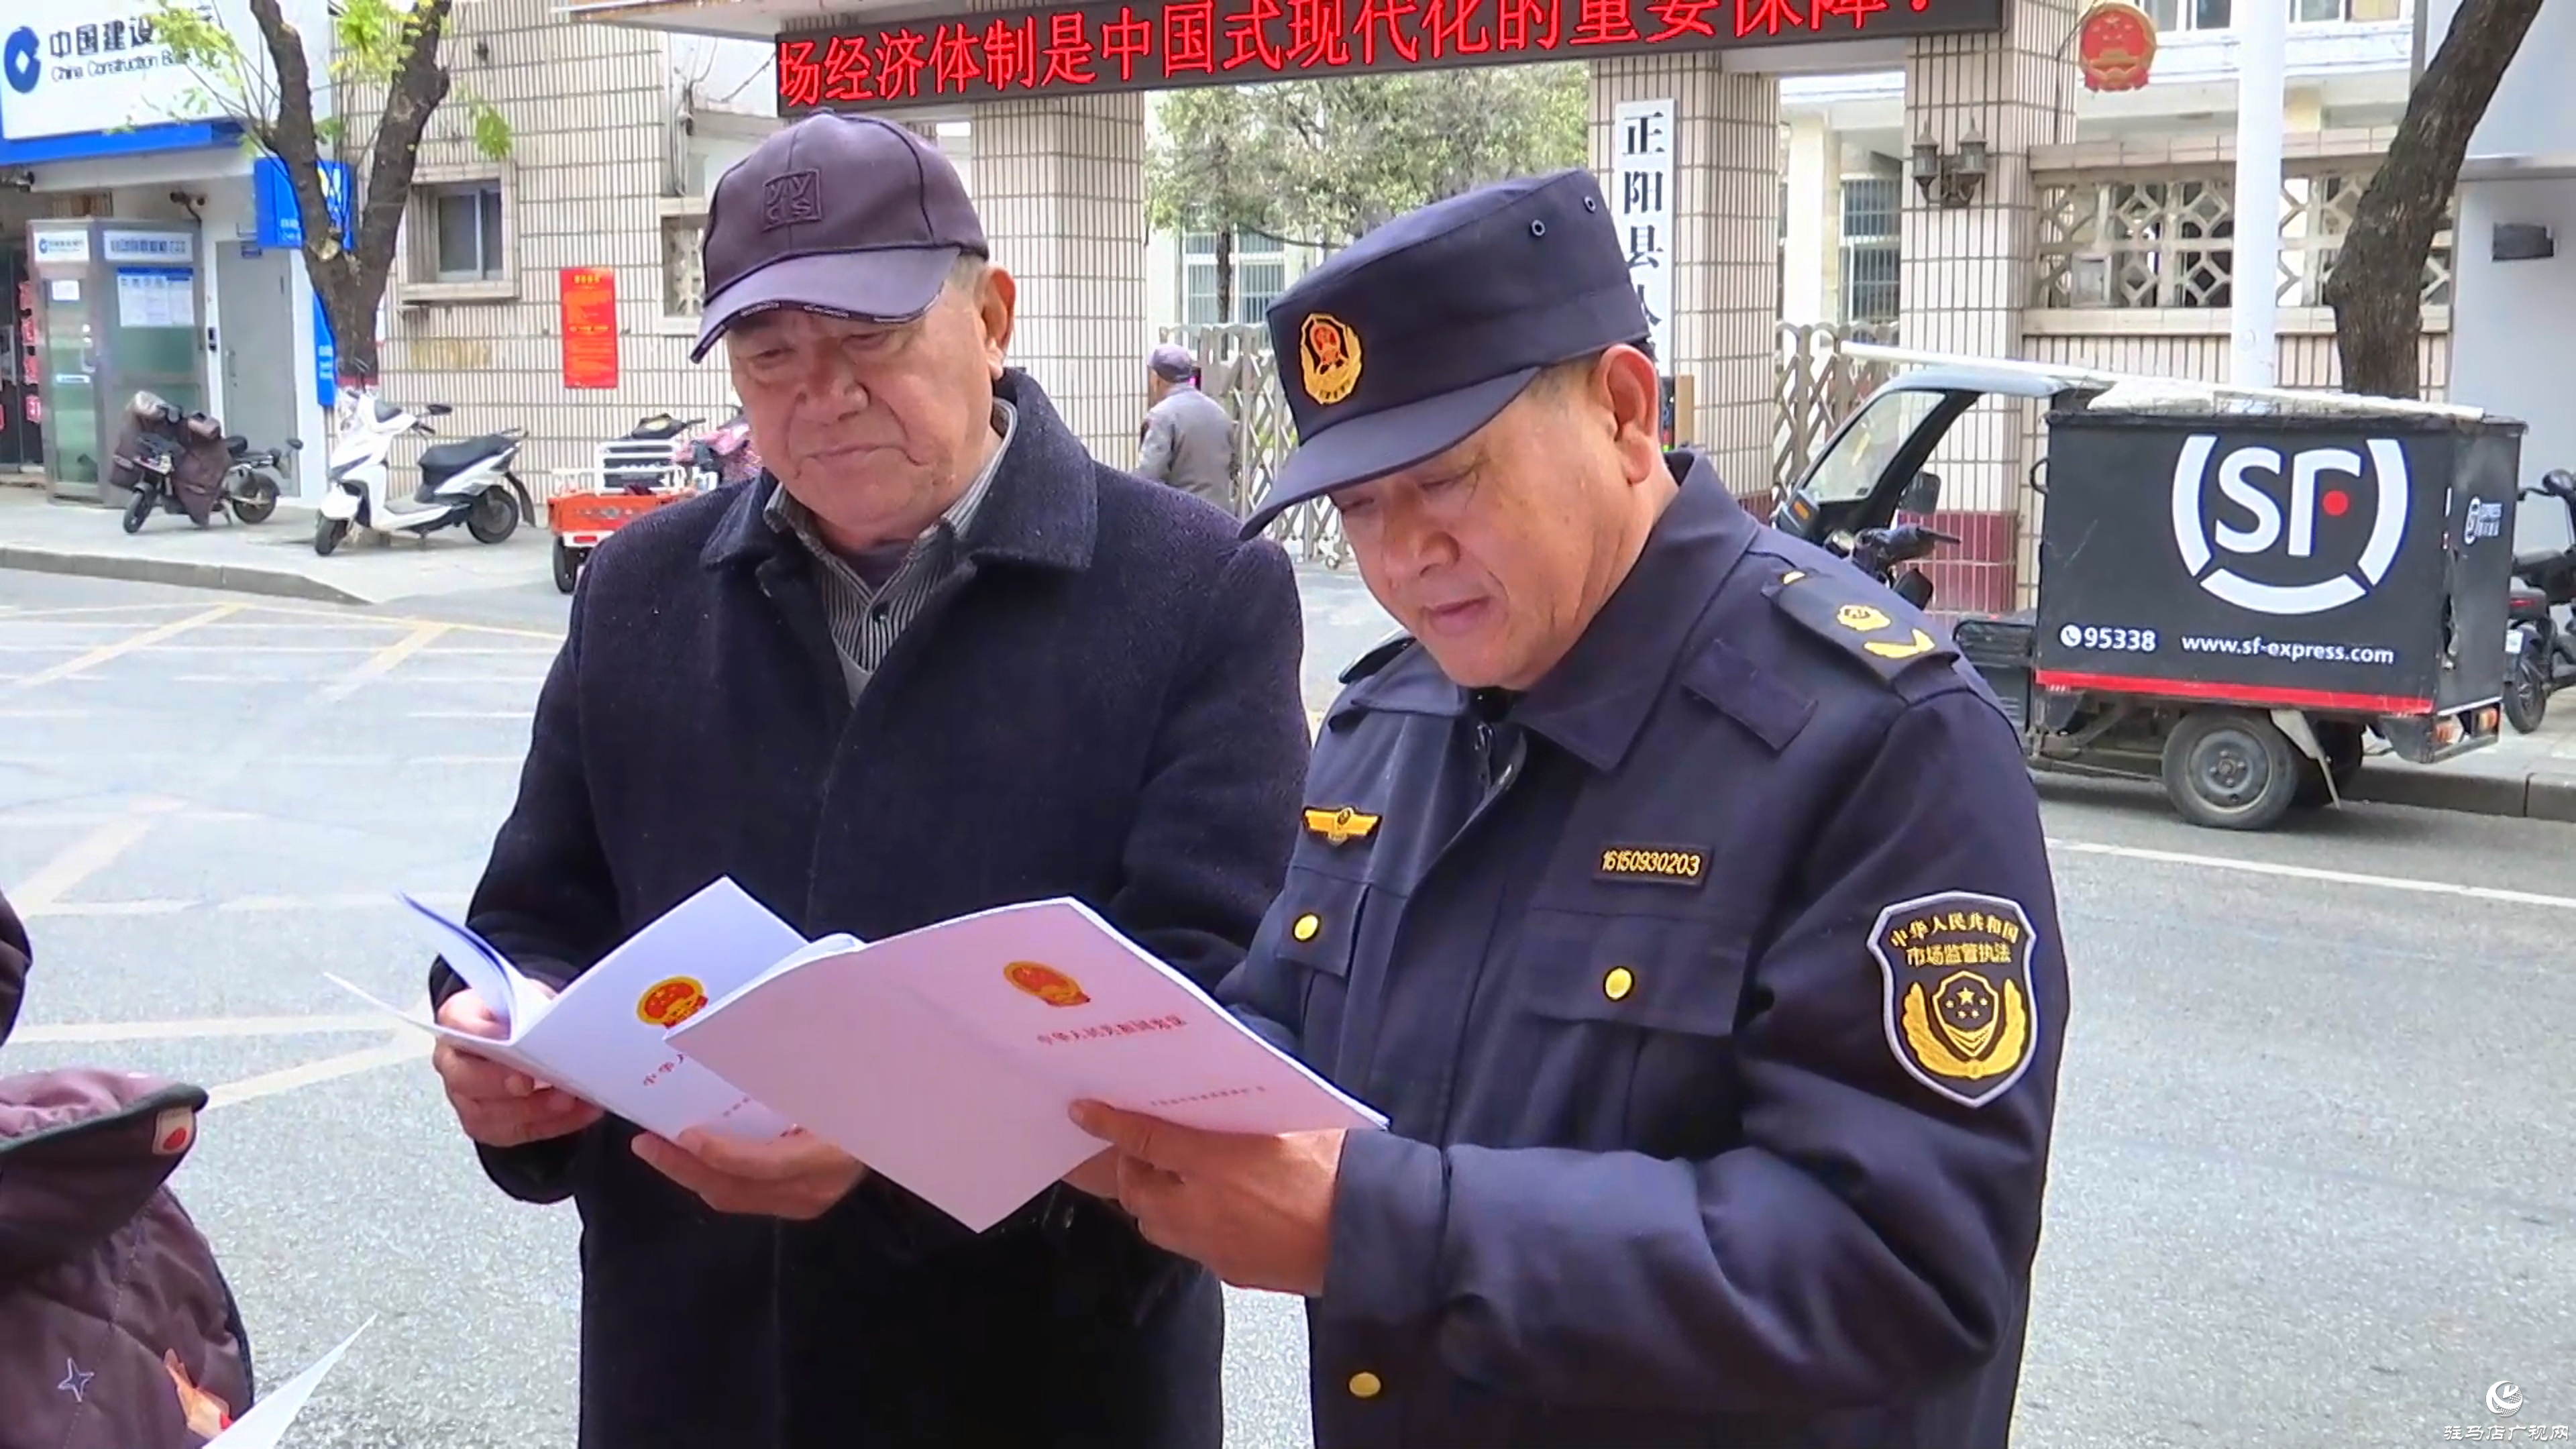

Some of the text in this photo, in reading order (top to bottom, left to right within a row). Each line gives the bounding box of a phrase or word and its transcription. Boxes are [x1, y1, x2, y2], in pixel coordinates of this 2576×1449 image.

[1622, 111, 1665, 362] 正阳县人
[2084, 627, 2155, 651] 95338
[2182, 636, 2394, 663] www.sf-express.com
[1602, 850, 1701, 876] 16150930203
[1890, 912, 2019, 947] 中华人民共和国
